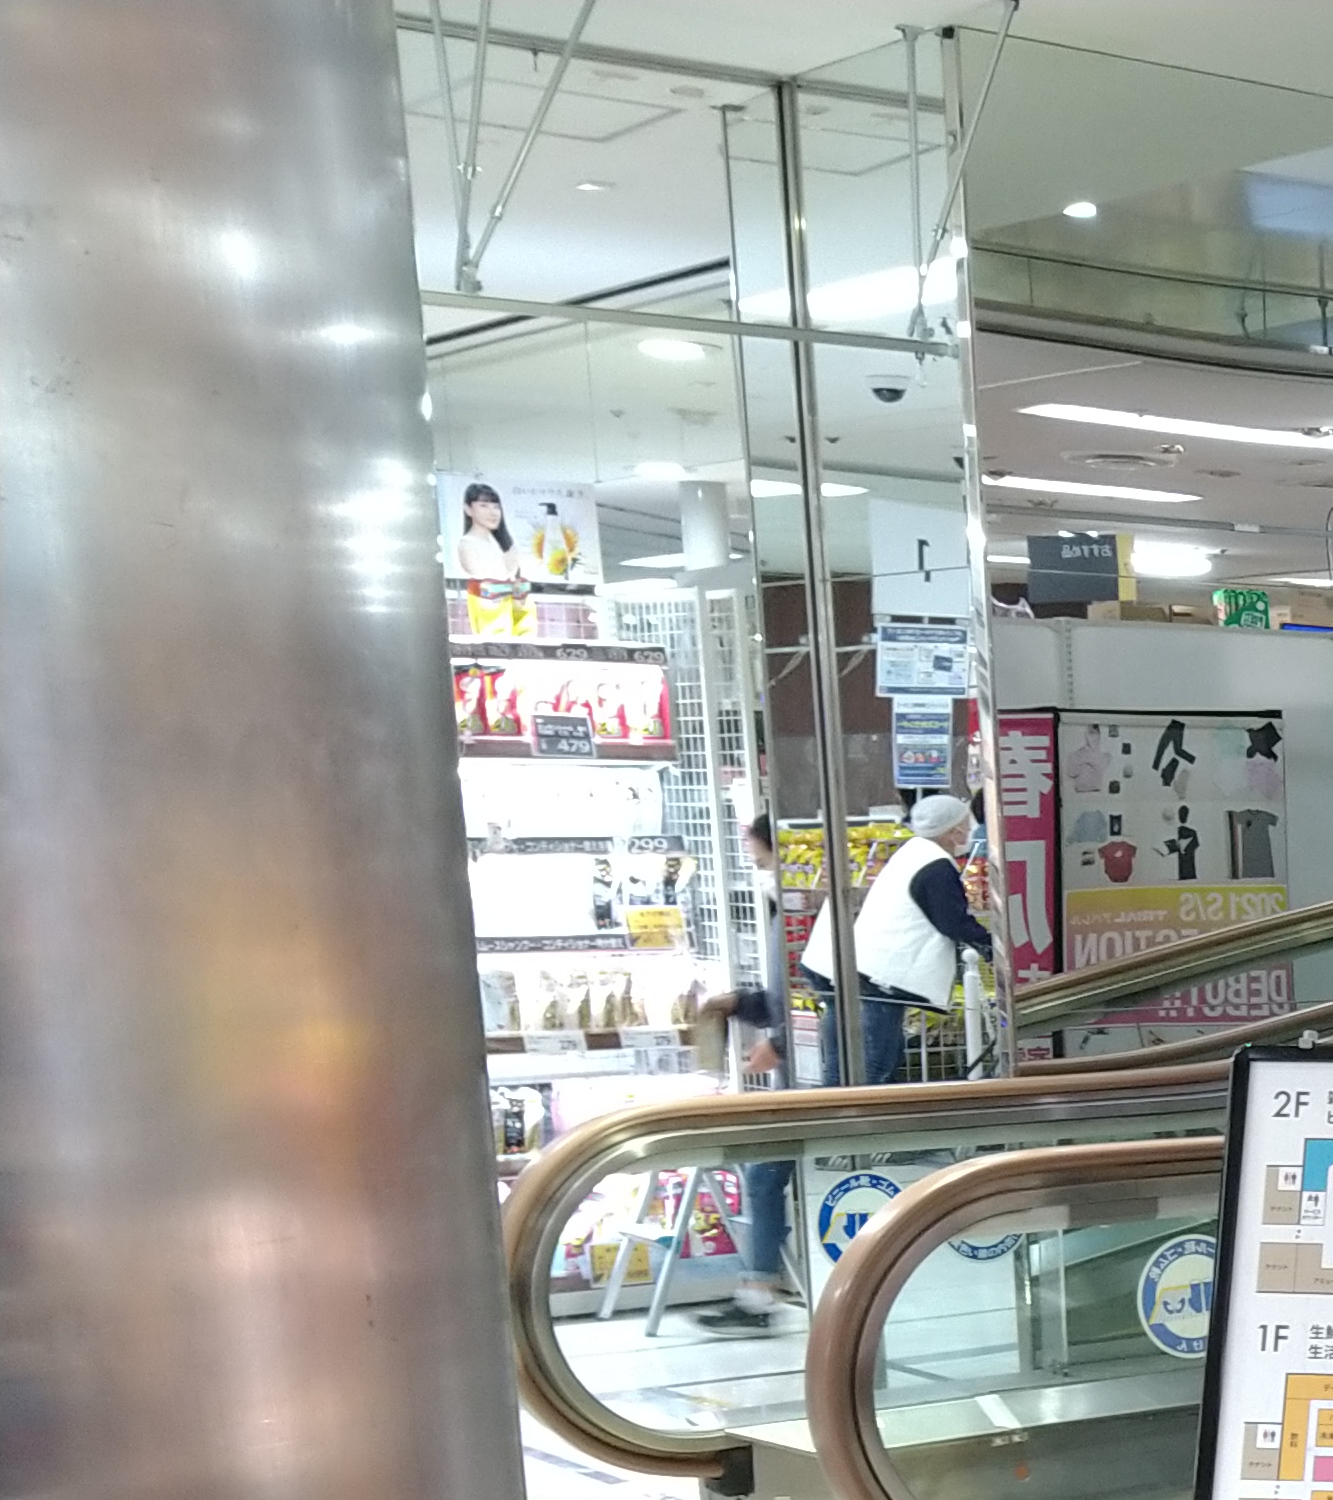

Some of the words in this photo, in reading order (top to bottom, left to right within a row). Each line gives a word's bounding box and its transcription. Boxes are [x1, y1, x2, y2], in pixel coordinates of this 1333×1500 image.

[628, 837, 668, 852] 299
[1272, 1090, 1311, 1118] 2F
[1258, 1324, 1290, 1352] 1F
